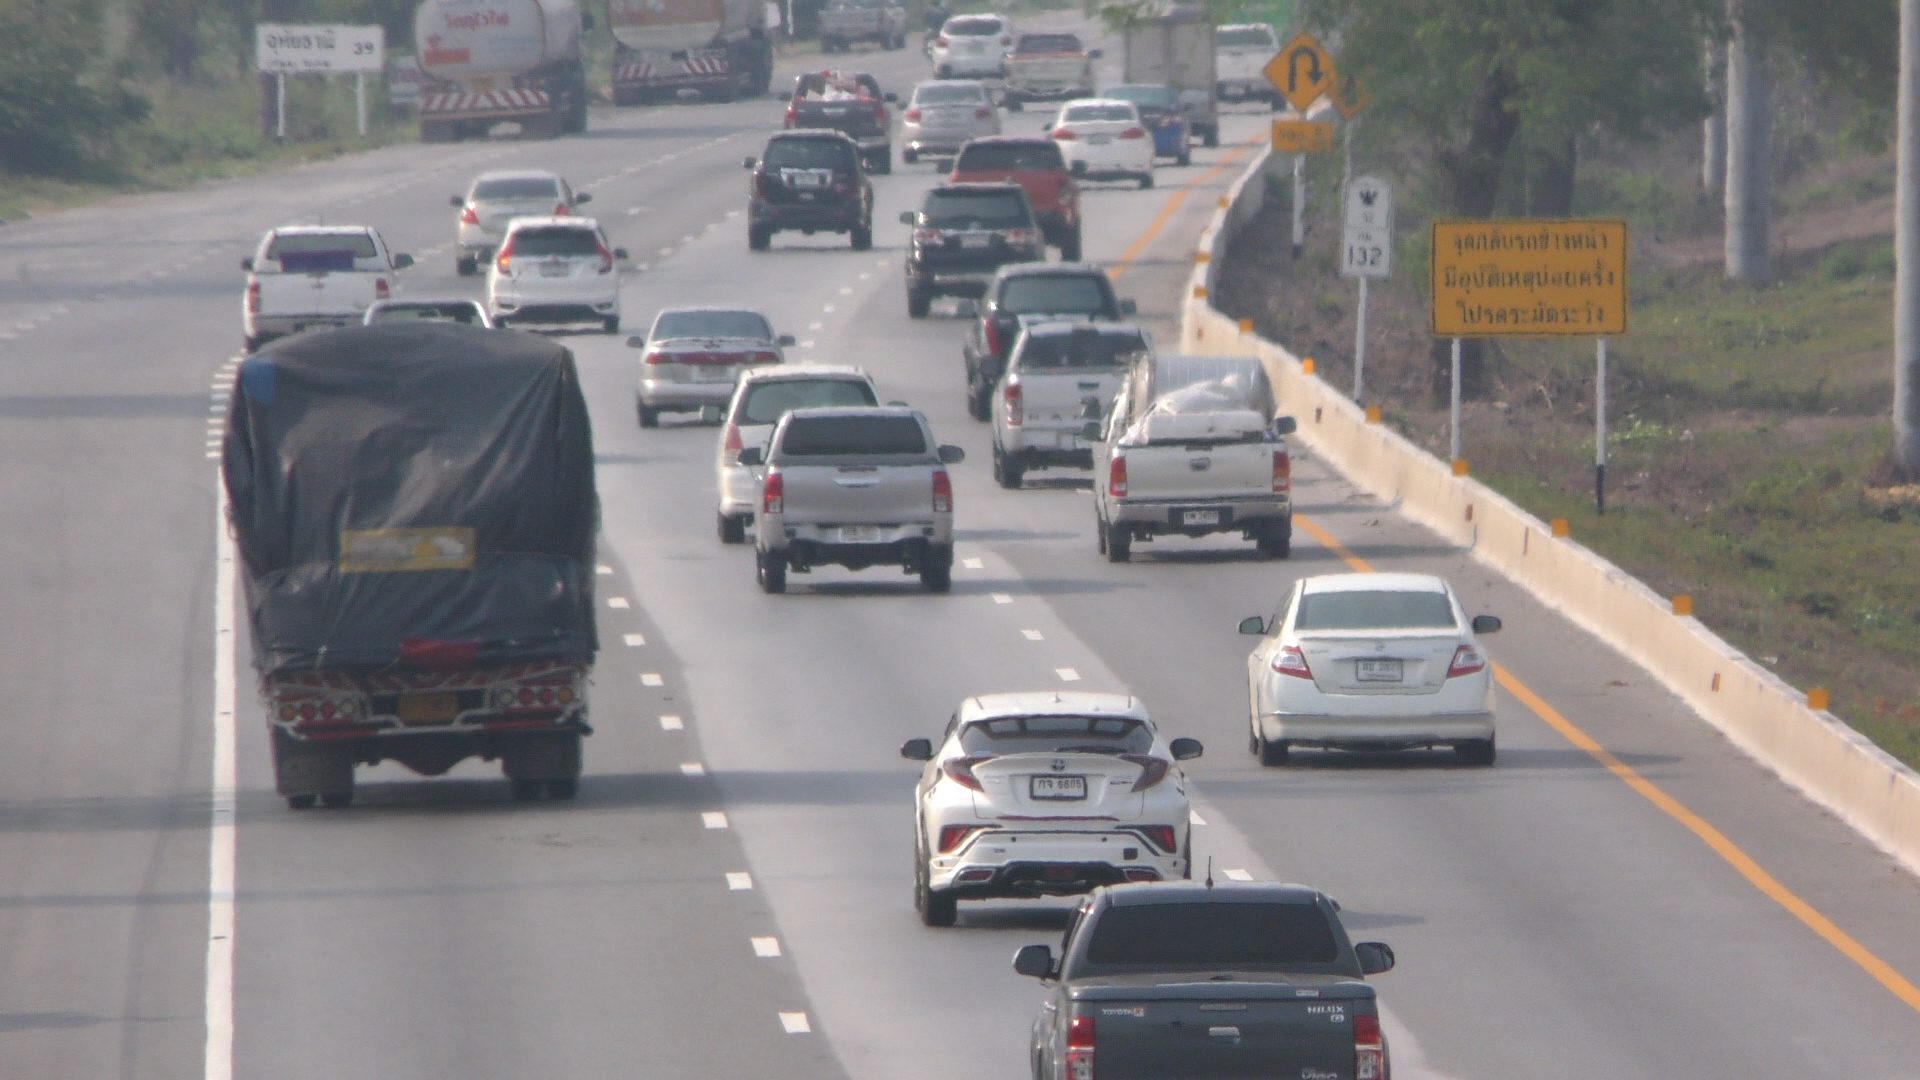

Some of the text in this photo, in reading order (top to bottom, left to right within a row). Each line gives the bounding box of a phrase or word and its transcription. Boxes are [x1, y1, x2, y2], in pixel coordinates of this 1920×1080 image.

[353, 42, 374, 55] 39
[1348, 246, 1382, 266] 132
[1307, 1006, 1344, 1014] HILUX
